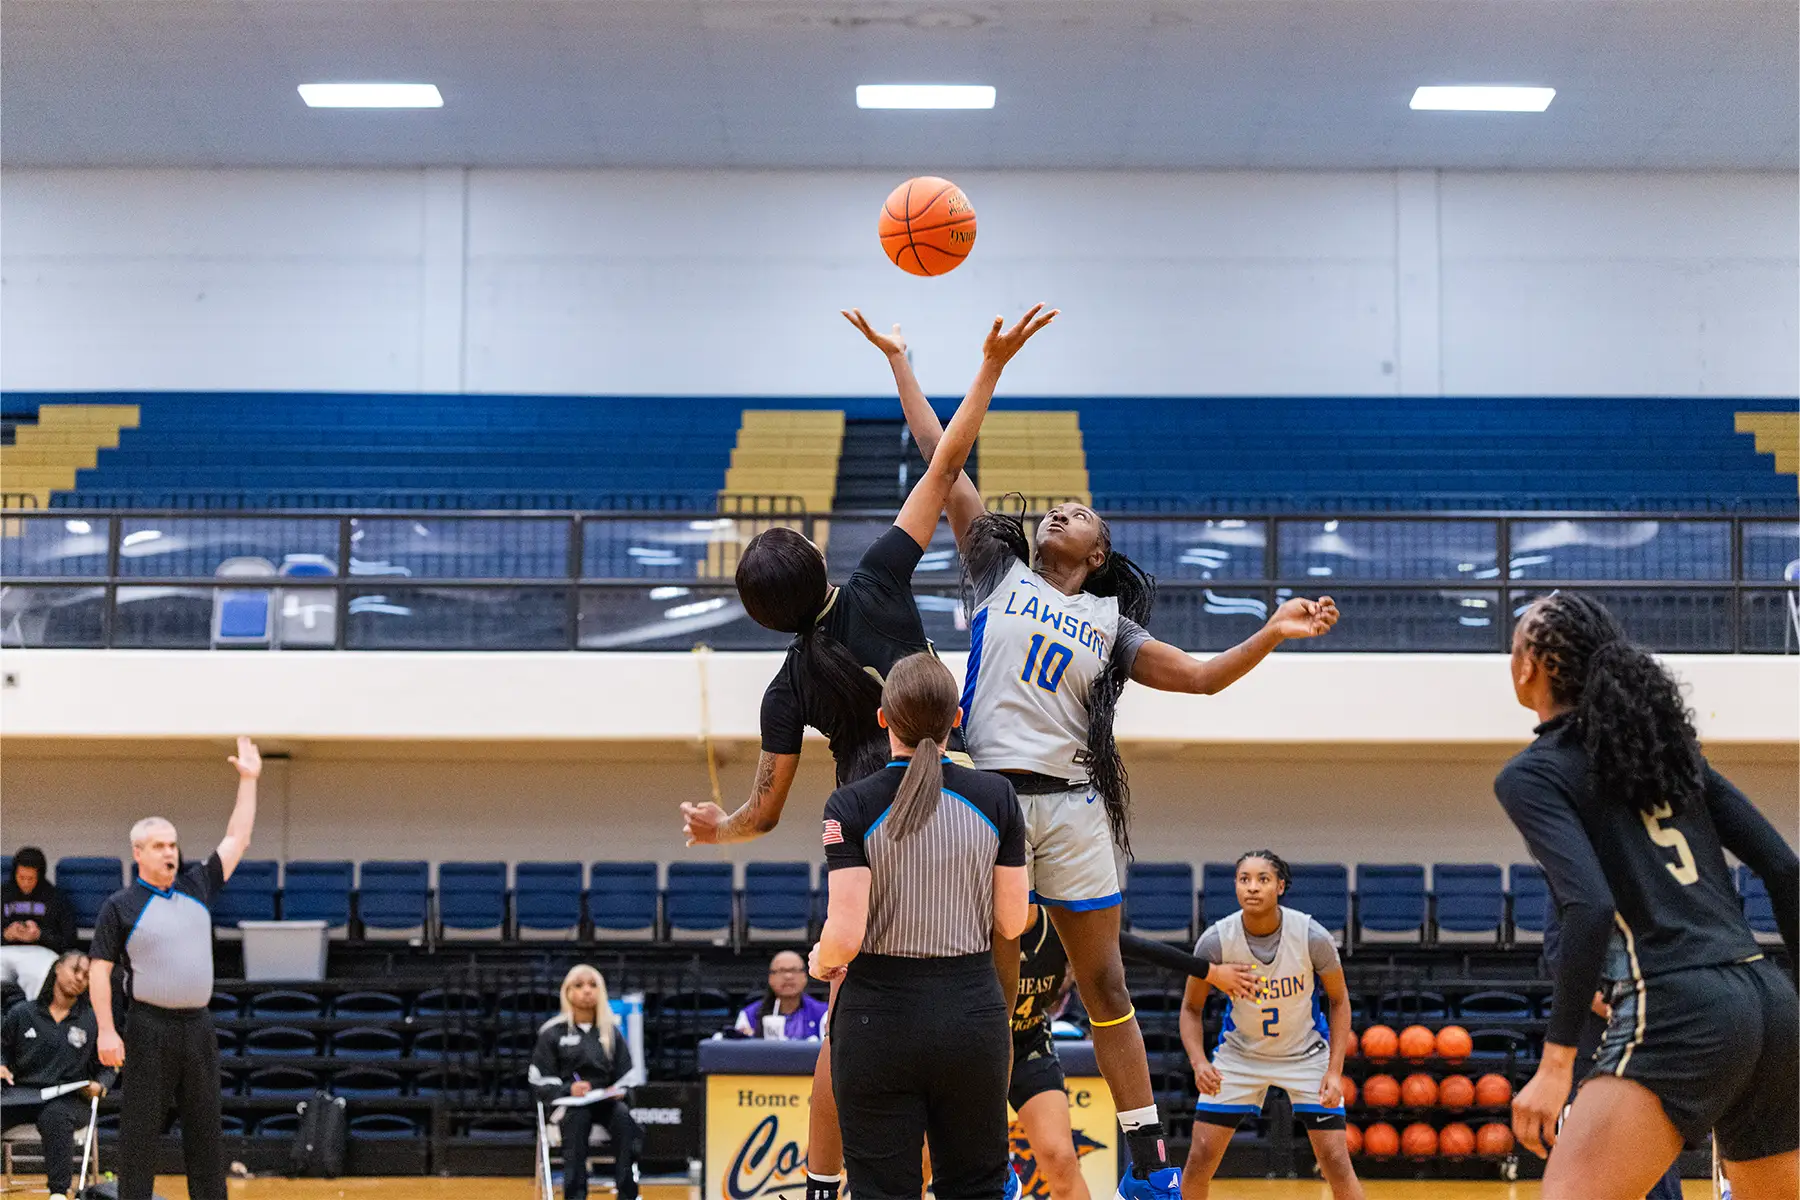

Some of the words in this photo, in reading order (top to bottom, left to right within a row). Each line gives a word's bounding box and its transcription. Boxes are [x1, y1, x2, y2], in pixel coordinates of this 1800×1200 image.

[1004, 591, 1104, 661] LAWSON
[1019, 632, 1074, 695] 10
[1640, 800, 1699, 886] 5
[1018, 975, 1055, 994] HEAST
[1015, 995, 1035, 1019] 4
[1261, 1007, 1280, 1037] 2
[737, 1089, 800, 1107] Home
